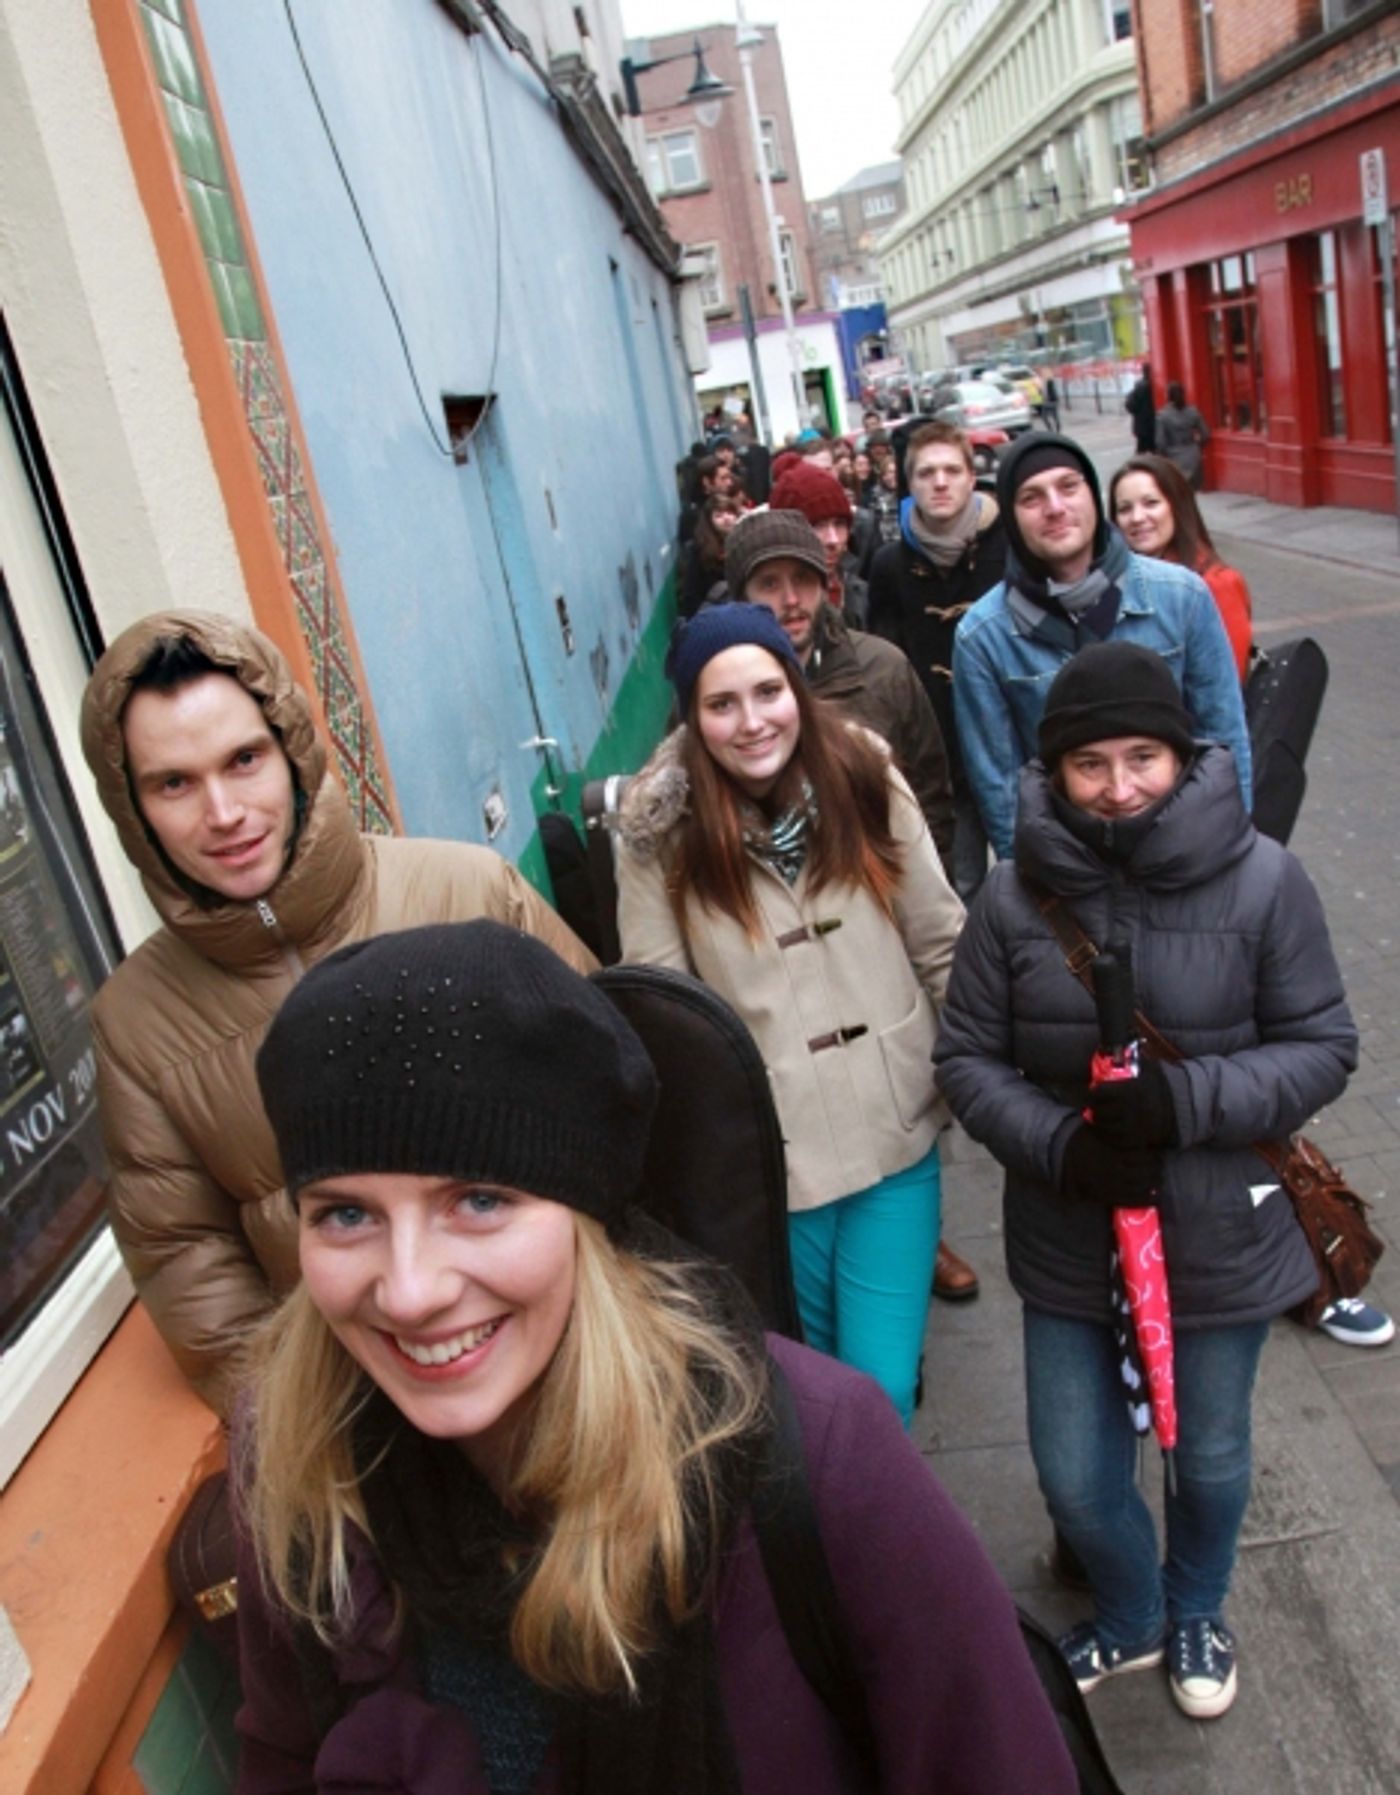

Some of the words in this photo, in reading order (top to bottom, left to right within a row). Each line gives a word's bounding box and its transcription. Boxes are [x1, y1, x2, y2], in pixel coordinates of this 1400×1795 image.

[1274, 174, 1313, 213] BAR
[6, 1082, 67, 1166] NOV
[68, 1047, 97, 1106] 201
